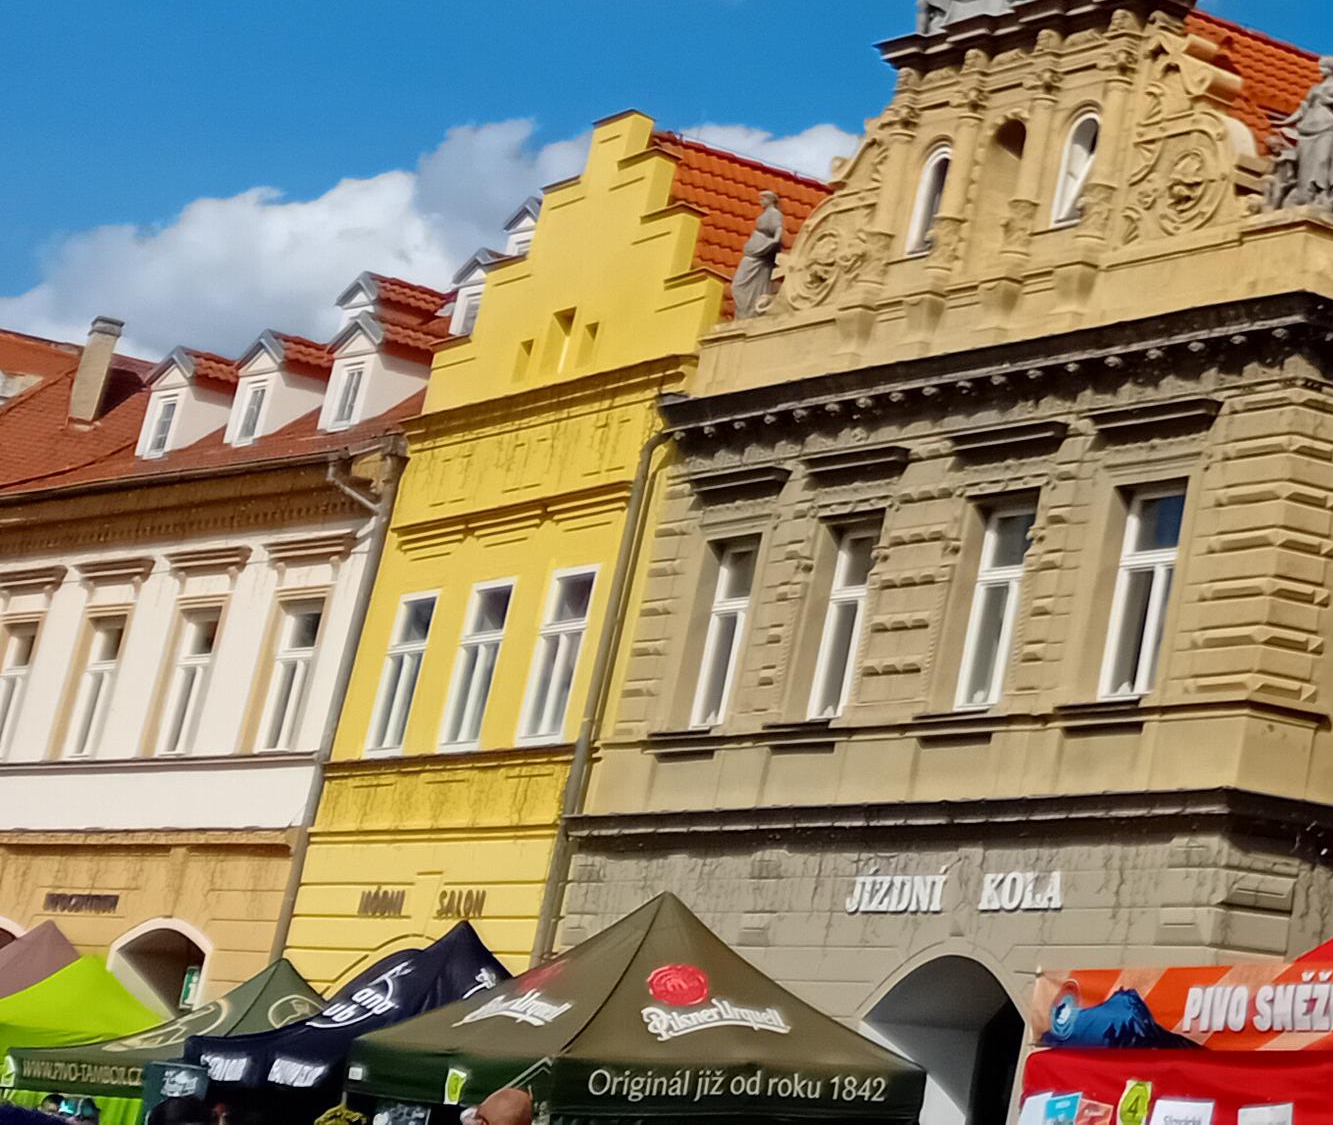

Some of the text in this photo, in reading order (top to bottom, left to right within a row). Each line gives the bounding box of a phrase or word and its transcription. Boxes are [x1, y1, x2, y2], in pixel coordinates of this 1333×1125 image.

[436, 889, 487, 918] SALON
[845, 866, 1063, 913] JÍZDNÍ KOLA
[641, 998, 787, 1041] Pilsner Urquell
[1182, 985, 1249, 1032] PIVO
[588, 1069, 887, 1102] Originál již od roku 1842
[1127, 1095, 1141, 1118] 4
